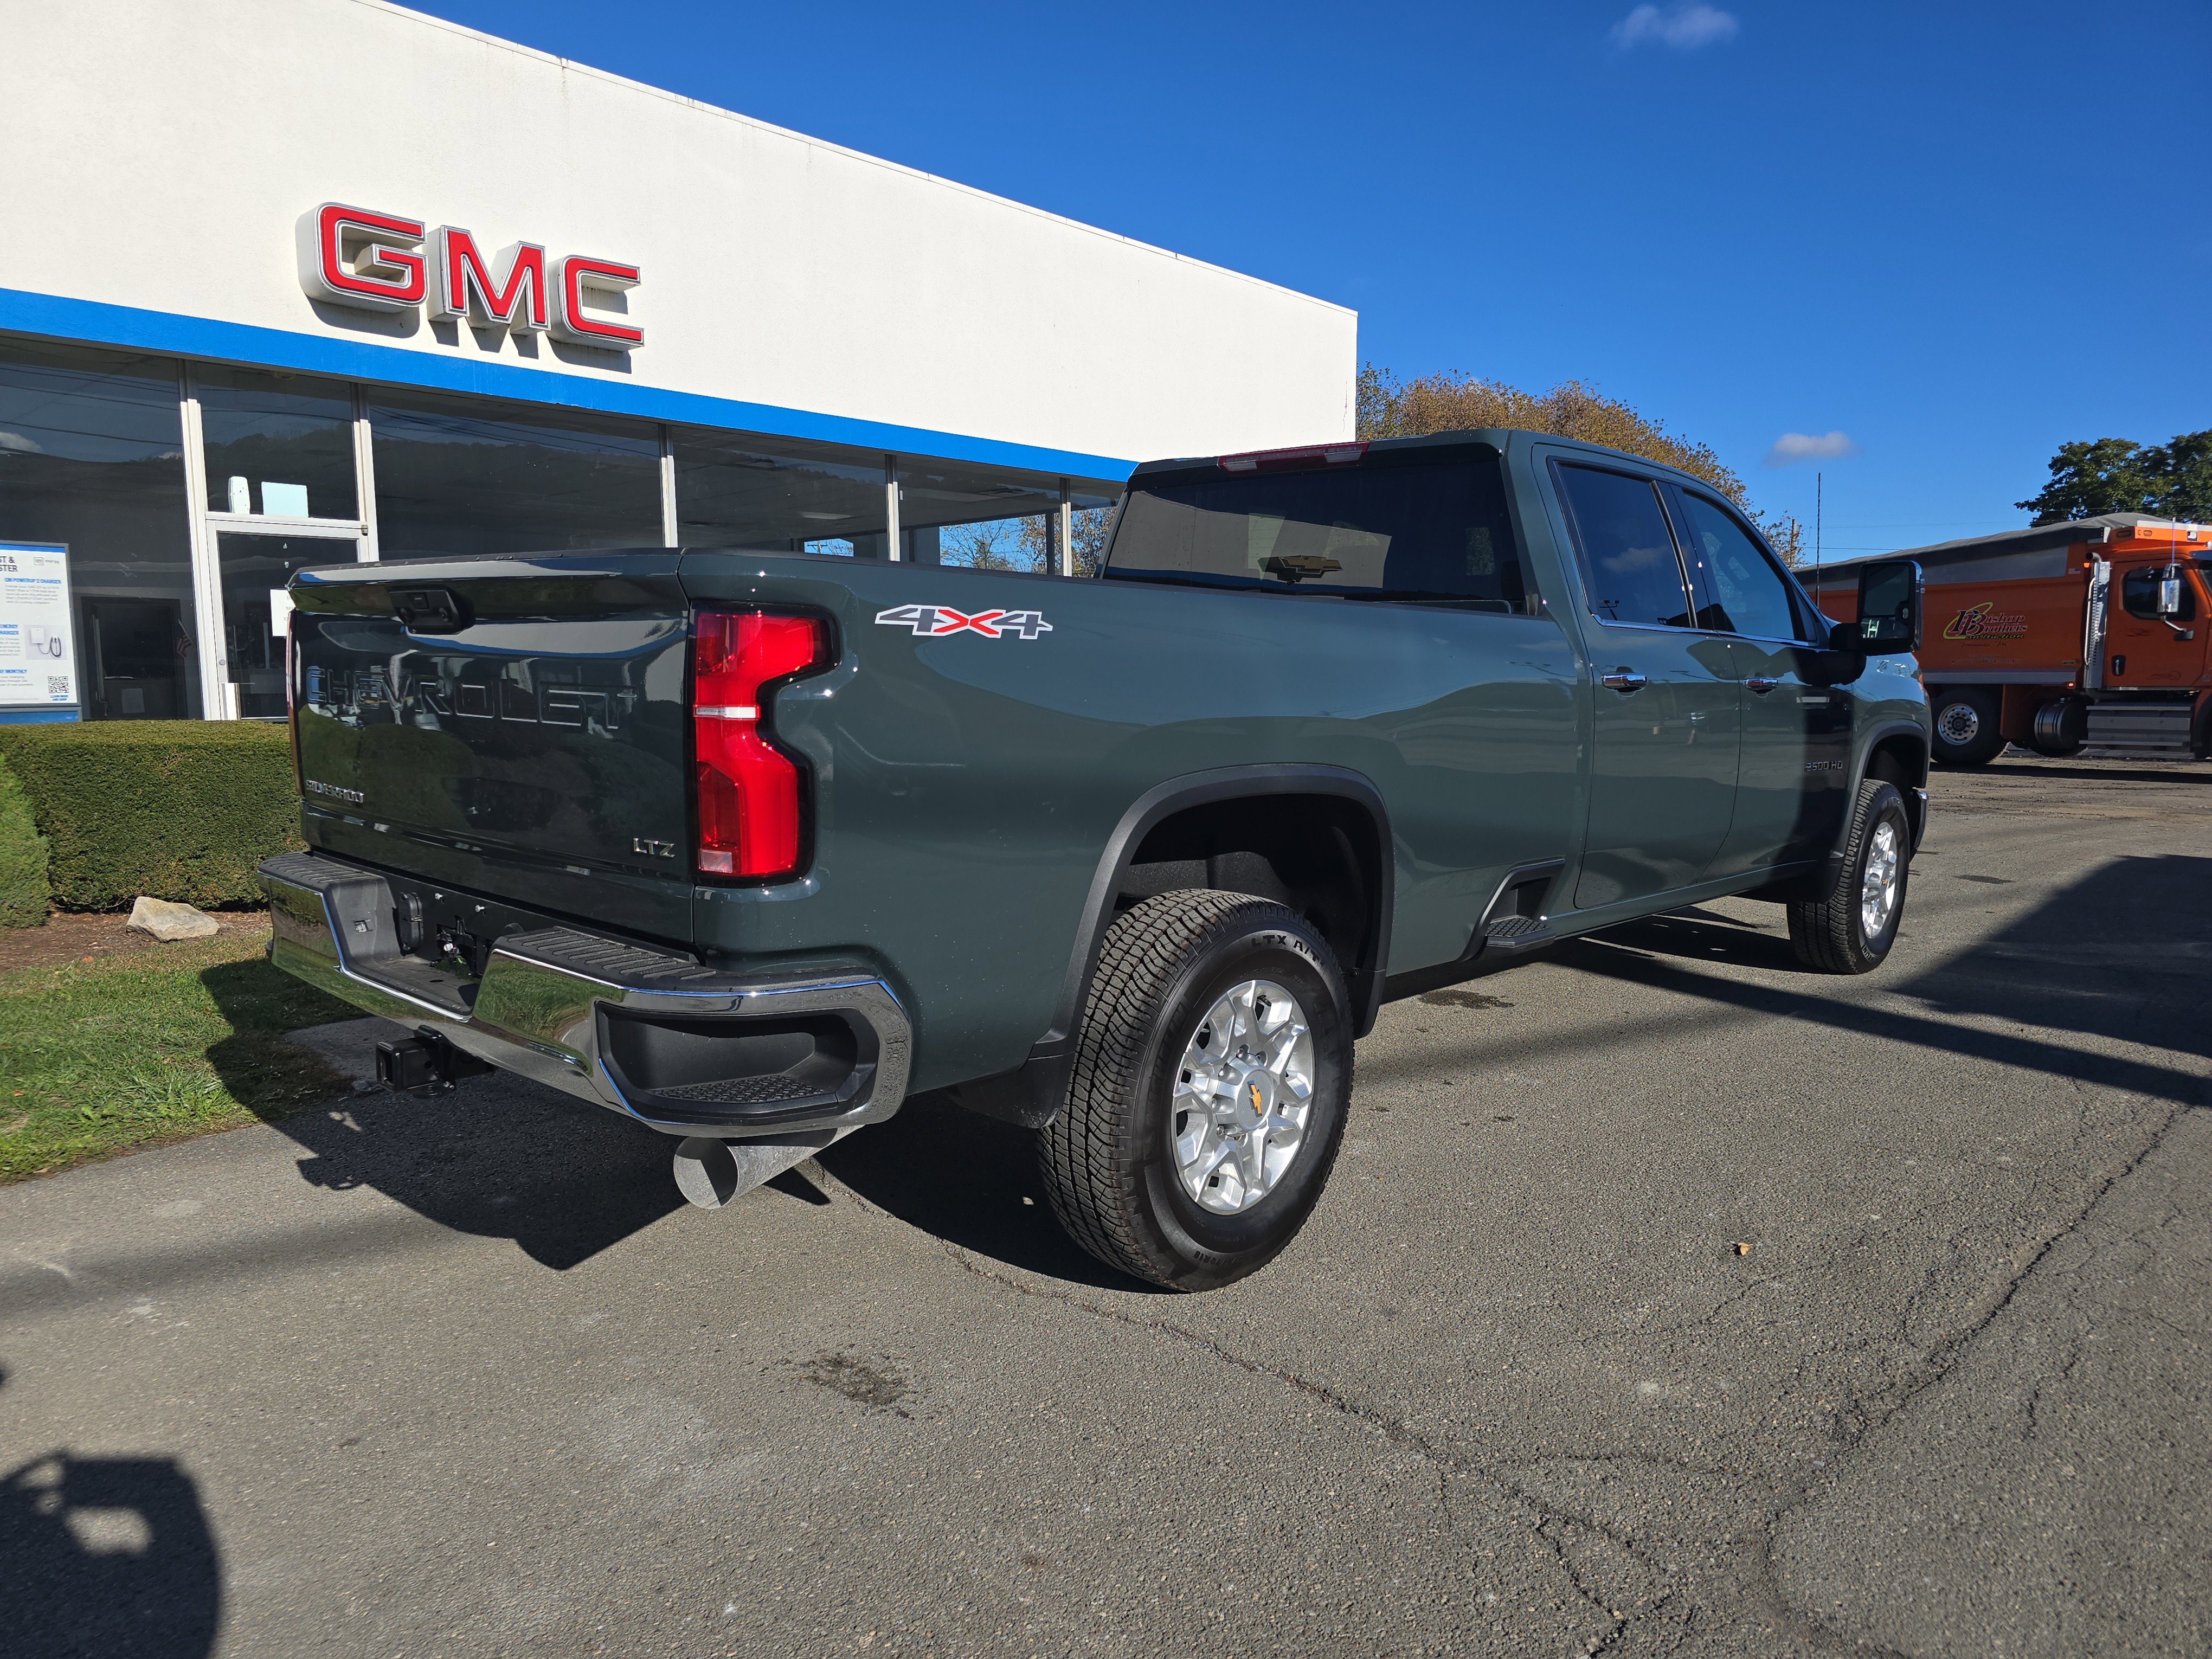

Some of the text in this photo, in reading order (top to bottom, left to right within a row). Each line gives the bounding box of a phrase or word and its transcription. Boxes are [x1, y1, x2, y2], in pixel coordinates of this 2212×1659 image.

[304, 202, 644, 351] GMC
[1956, 613, 2028, 636] Brothers
[306, 665, 639, 730] CHEVROLET
[1831, 760, 1843, 769] HD
[305, 779, 365, 803] SILVERADO
[633, 837, 676, 858] LTZ
[1250, 934, 1287, 947] LTX
